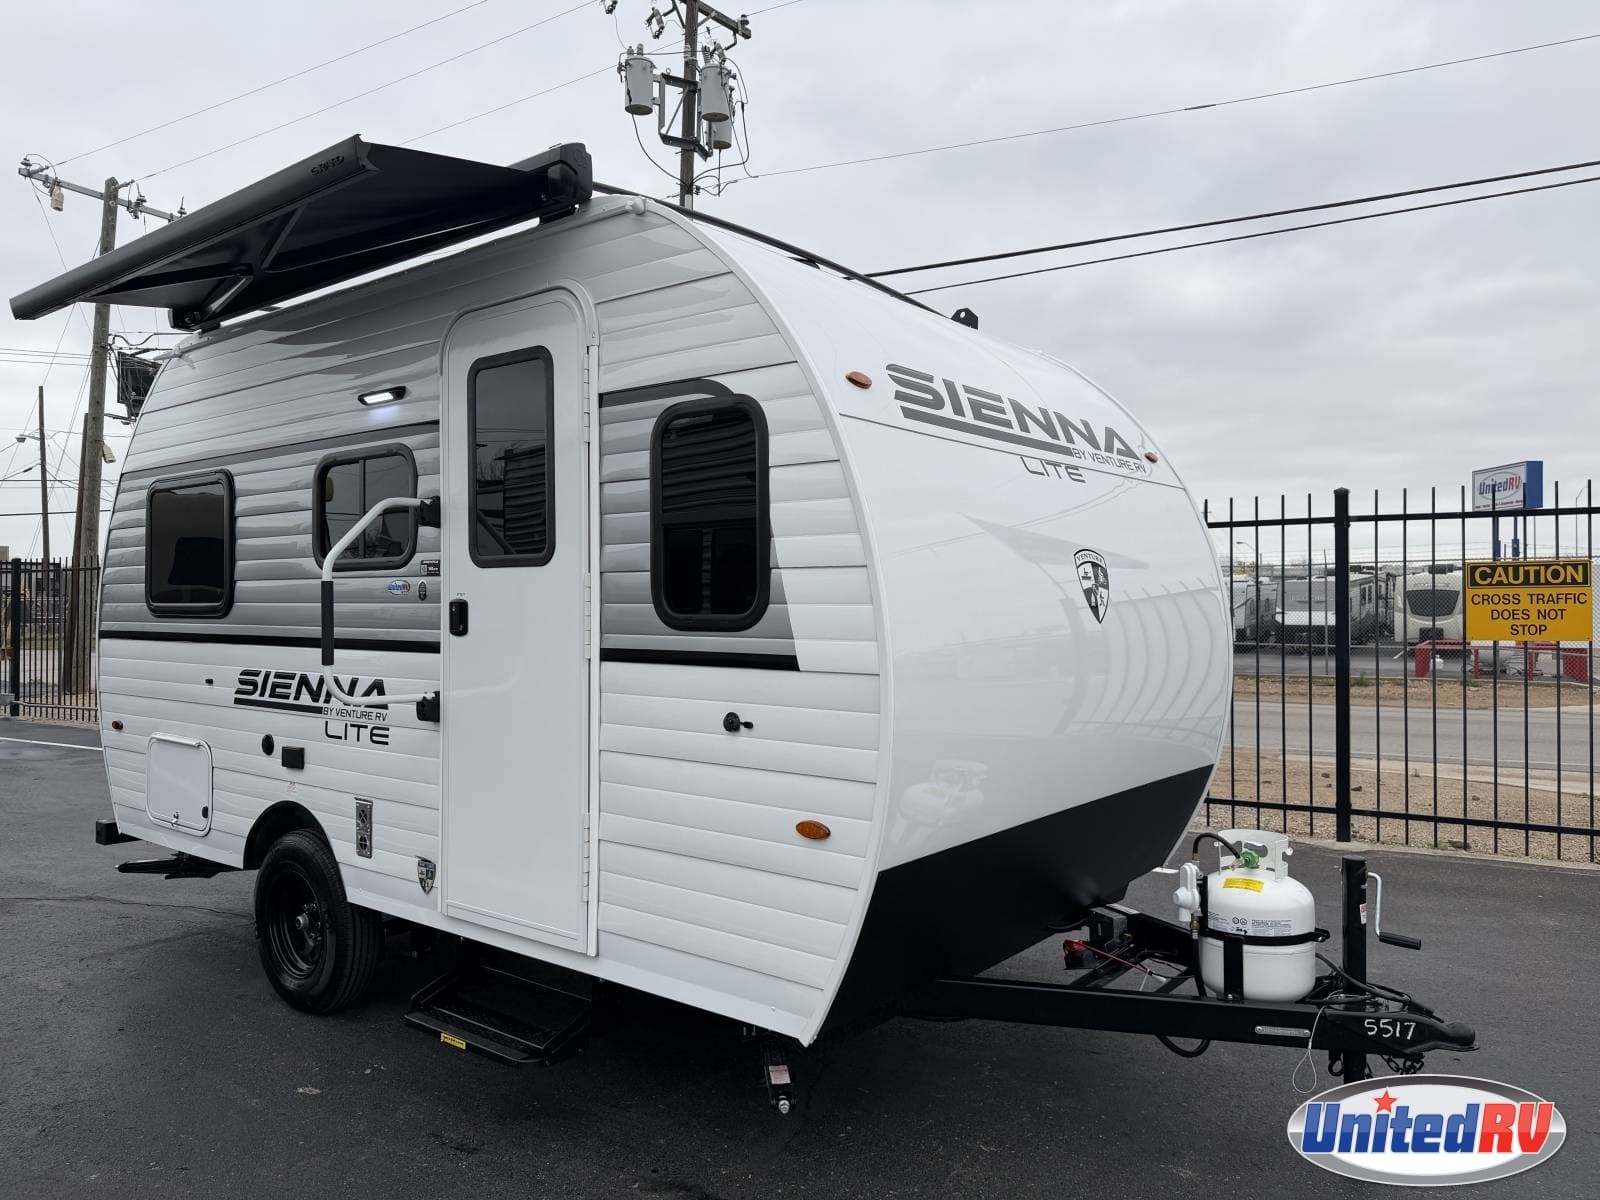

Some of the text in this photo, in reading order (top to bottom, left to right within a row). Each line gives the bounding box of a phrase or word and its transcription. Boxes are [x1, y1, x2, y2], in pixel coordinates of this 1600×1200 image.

[886, 364, 1141, 461] SIENNA
[1020, 455, 1086, 484] LITE
[1071, 447, 1088, 459] BY
[1088, 452, 1135, 472] VENTURE
[1474, 564, 1583, 584] CAUTION
[1471, 592, 1588, 606] CROSS TRAFFIC
[1491, 608, 1567, 621] DOES NOT
[1510, 624, 1548, 636] STOP
[234, 668, 389, 710] SIENNA
[323, 706, 388, 722] BY VENTURE RV
[325, 720, 390, 745] LITE
[1364, 1018, 1417, 1040] 5517
